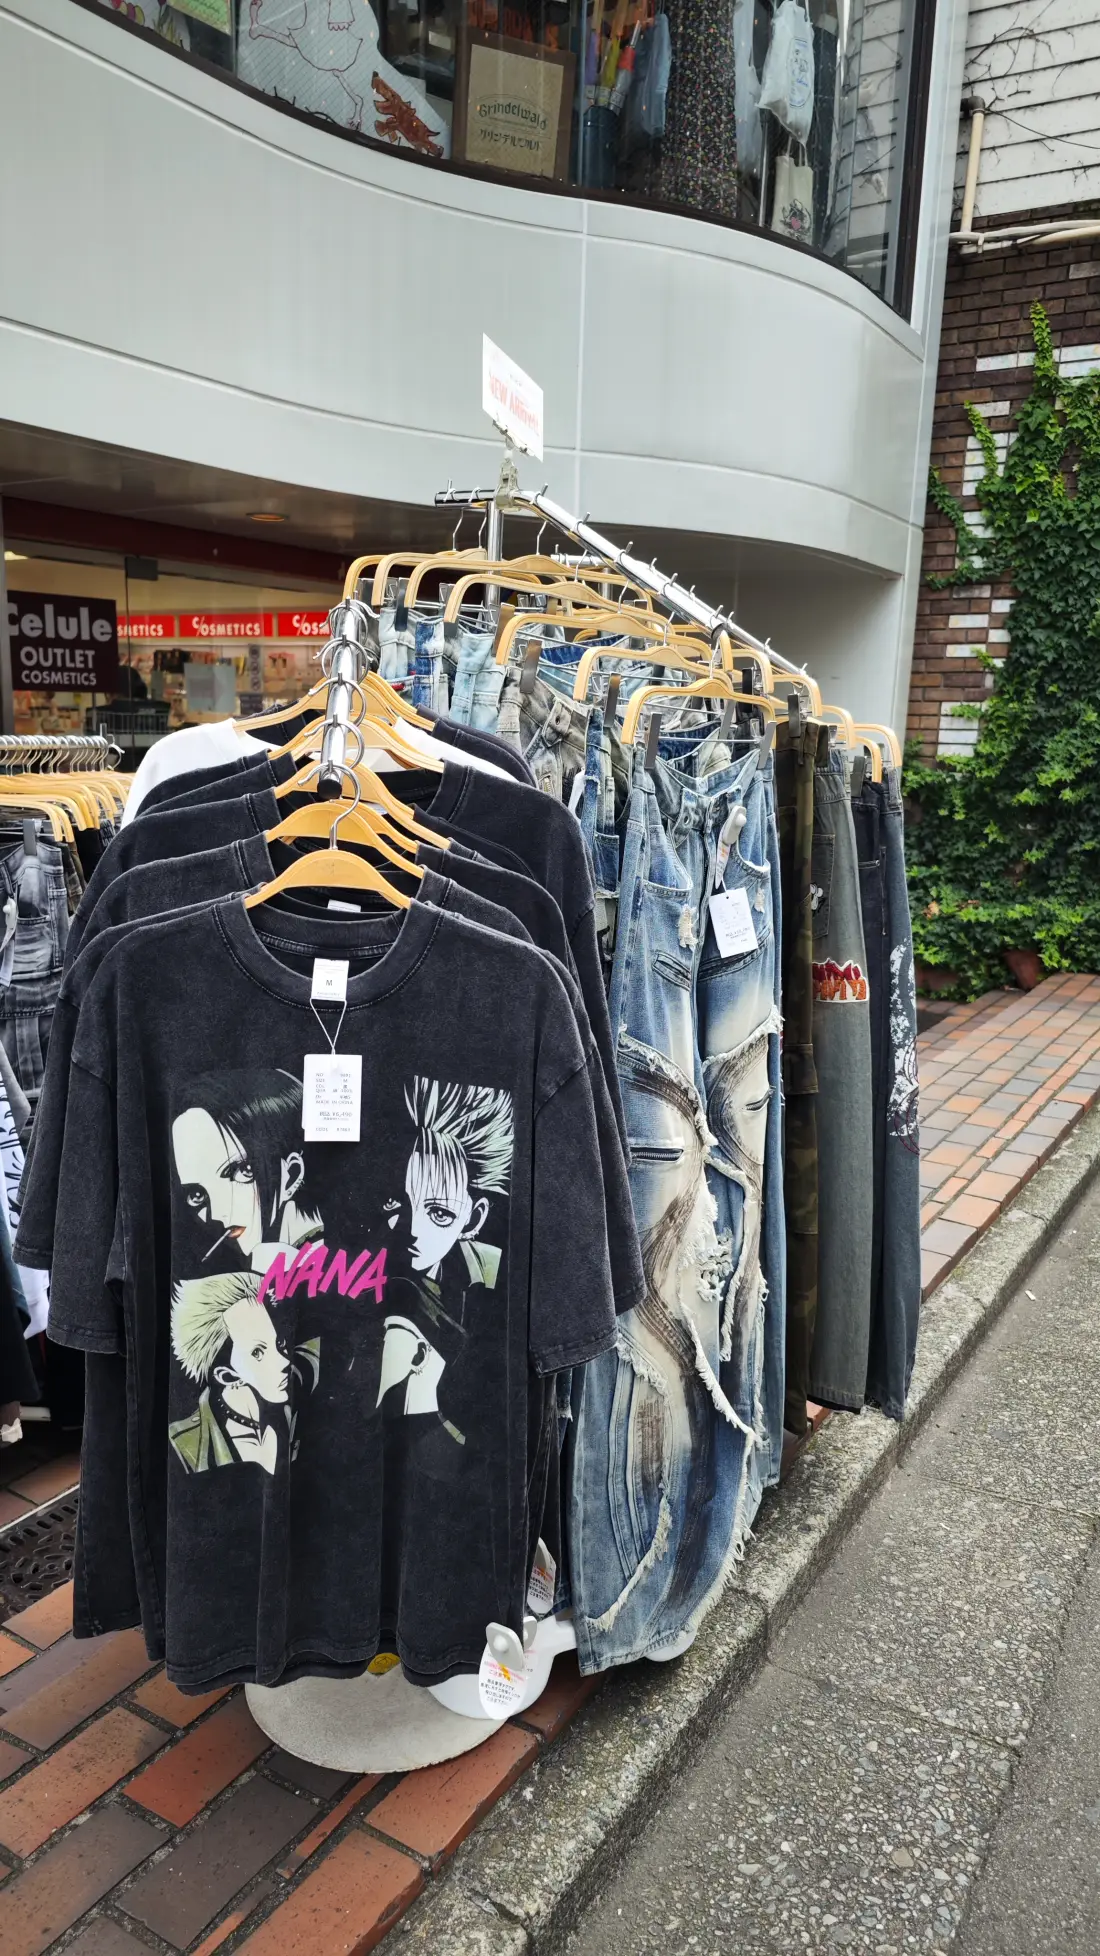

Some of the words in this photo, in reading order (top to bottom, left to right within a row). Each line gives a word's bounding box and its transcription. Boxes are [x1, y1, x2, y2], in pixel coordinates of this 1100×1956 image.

[20, 645, 96, 668] OUTLET
[21, 670, 97, 686] COSMETICS
[257, 1241, 388, 1305] NANA
